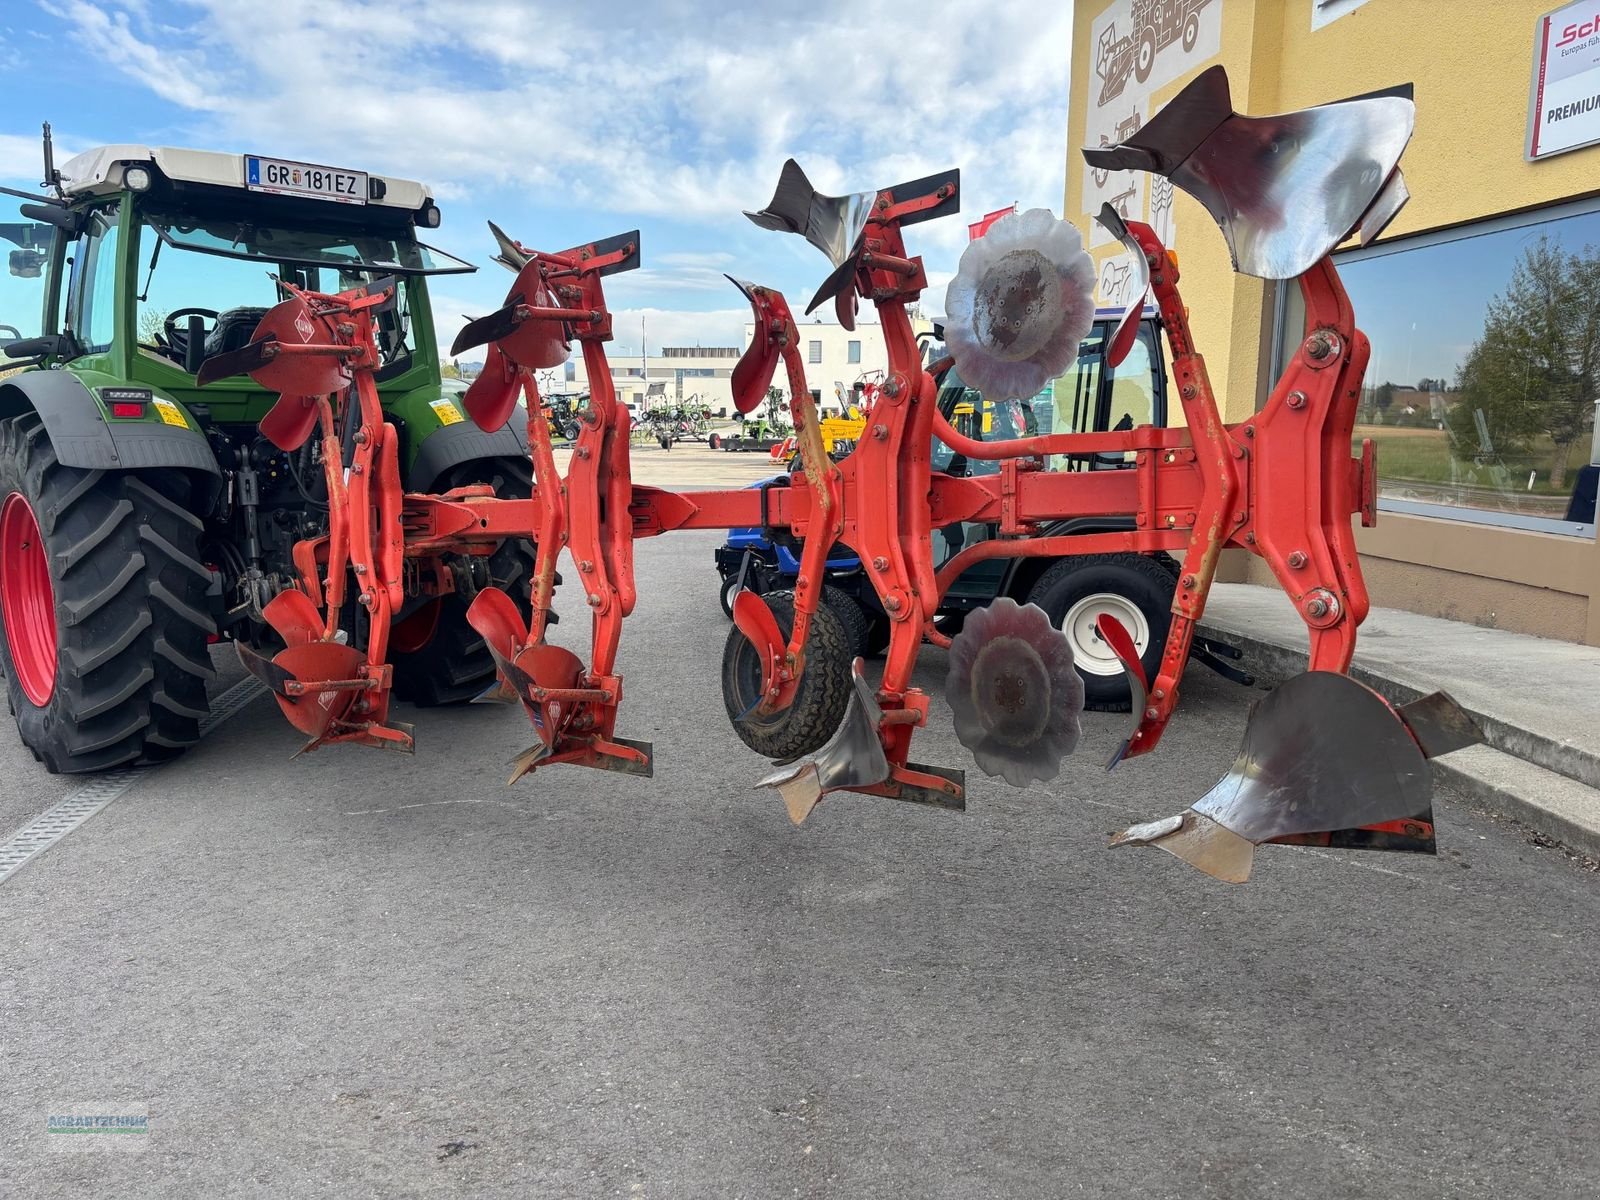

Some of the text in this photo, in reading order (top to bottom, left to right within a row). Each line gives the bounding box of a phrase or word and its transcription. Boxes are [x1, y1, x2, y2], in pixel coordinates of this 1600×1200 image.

[1561, 35, 1600, 57] Europas füh
[267, 164, 356, 194] GR 181EZ
